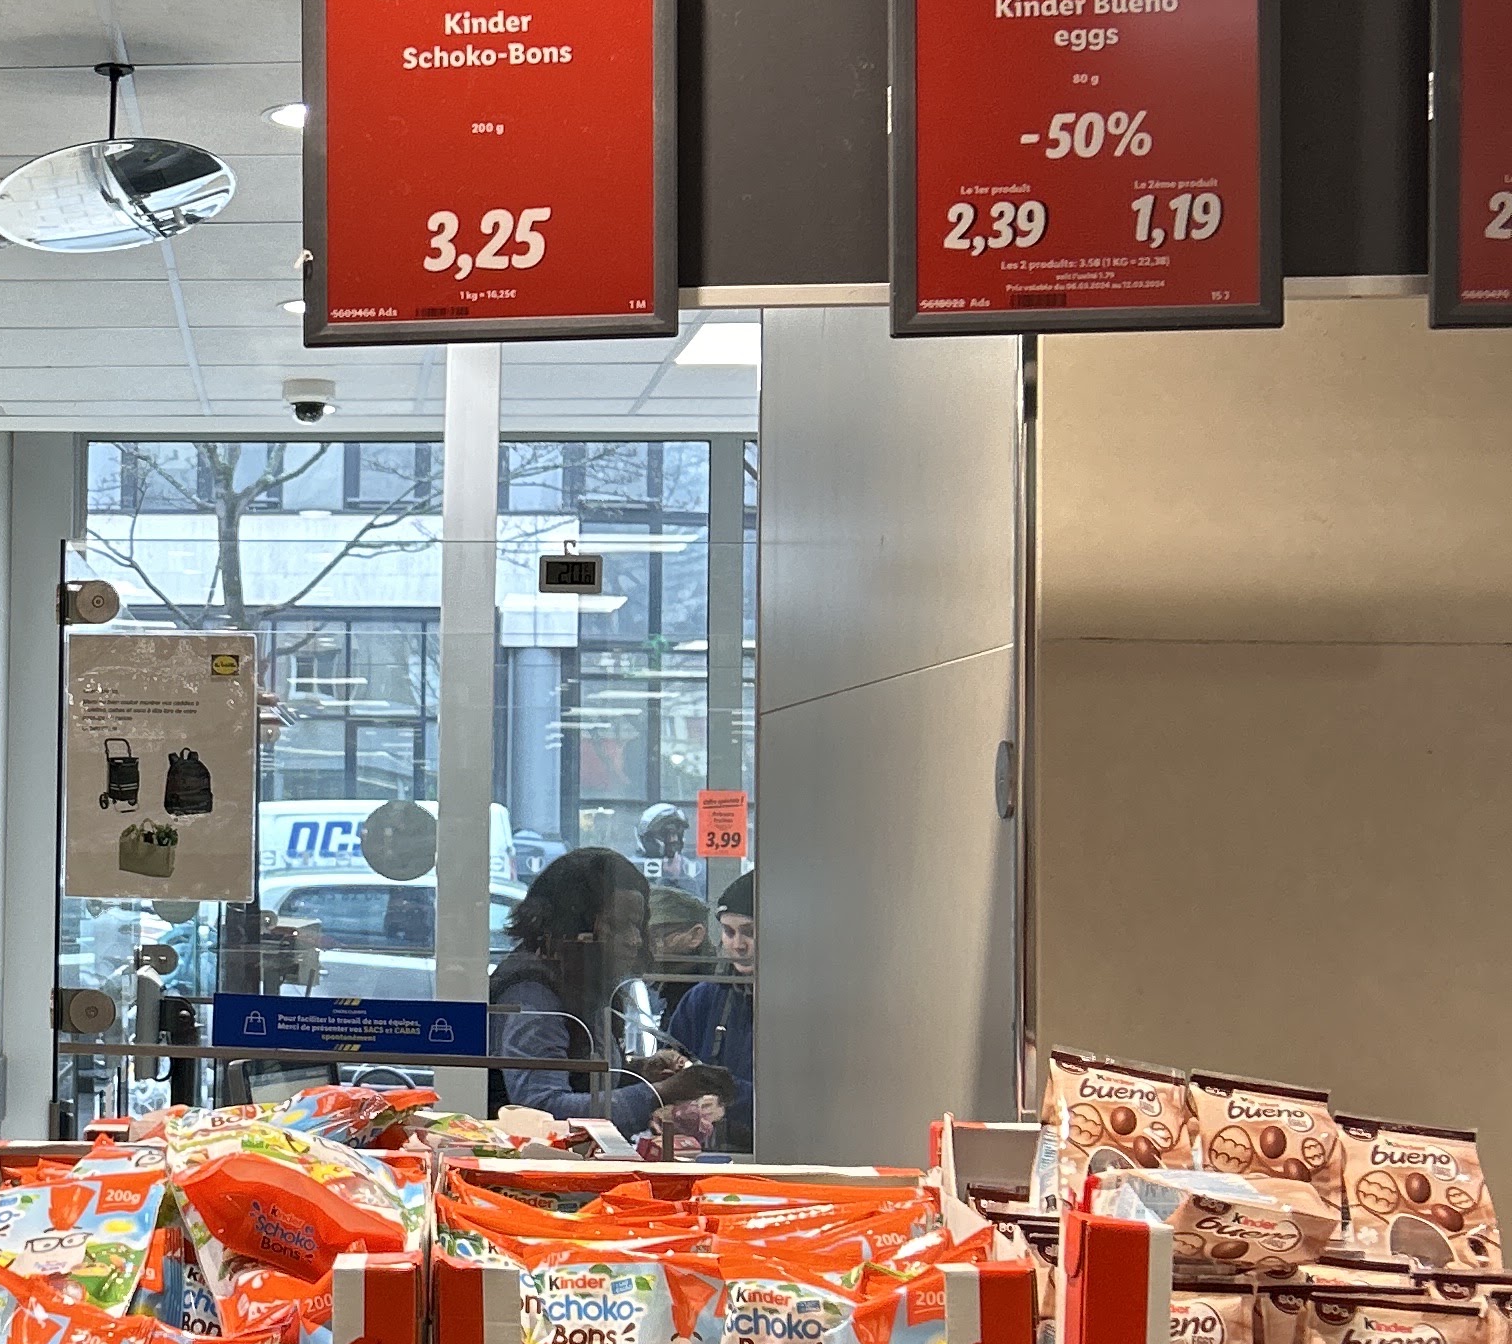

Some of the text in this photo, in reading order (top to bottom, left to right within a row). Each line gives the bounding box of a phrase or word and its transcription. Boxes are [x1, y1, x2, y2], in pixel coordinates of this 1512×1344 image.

[444, 12, 532, 36] Kinder
[1054, 26, 1119, 51] eggs
[403, 42, 573, 70] Schoko-Bons
[471, 122, 493, 134] 200
[1020, 110, 1152, 160] -50%
[991, 184, 1031, 195] produit
[1178, 178, 1218, 189] produit
[943, 200, 1047, 256] 2,39
[1131, 192, 1222, 248] 1,19
[423, 206, 552, 280] 3,25
[706, 832, 741, 850] 3,99
[1079, 1079, 1156, 1103] bueno
[1228, 1100, 1305, 1119] bueno
[1371, 1144, 1451, 1167] bueno
[105, 1188, 142, 1204] 200g
